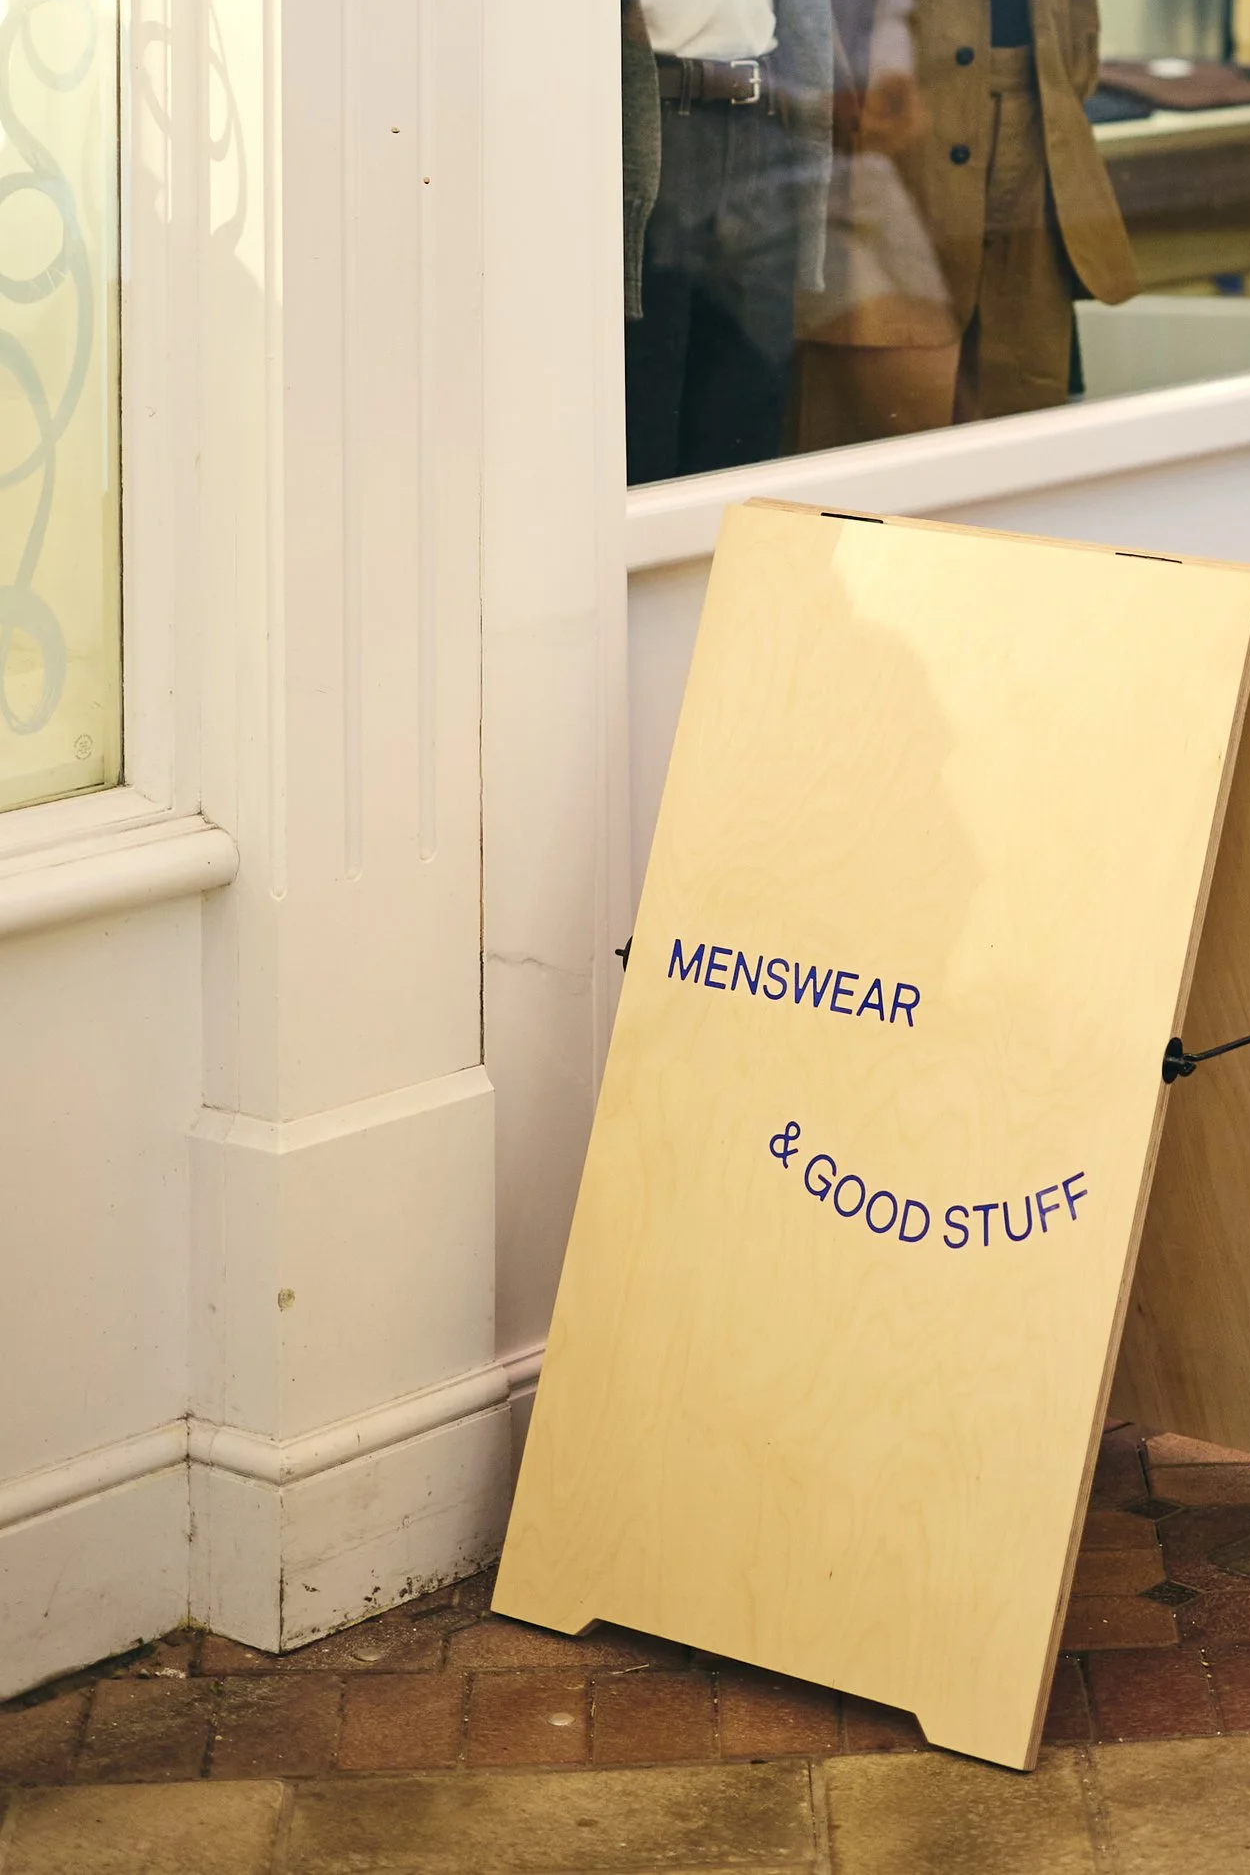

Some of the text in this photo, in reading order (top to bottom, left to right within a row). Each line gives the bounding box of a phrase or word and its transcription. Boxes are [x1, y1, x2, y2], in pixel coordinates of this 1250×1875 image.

[668, 938, 921, 1027] MENSWEAR
[769, 1121, 1088, 1249] & GOOD STUFF
